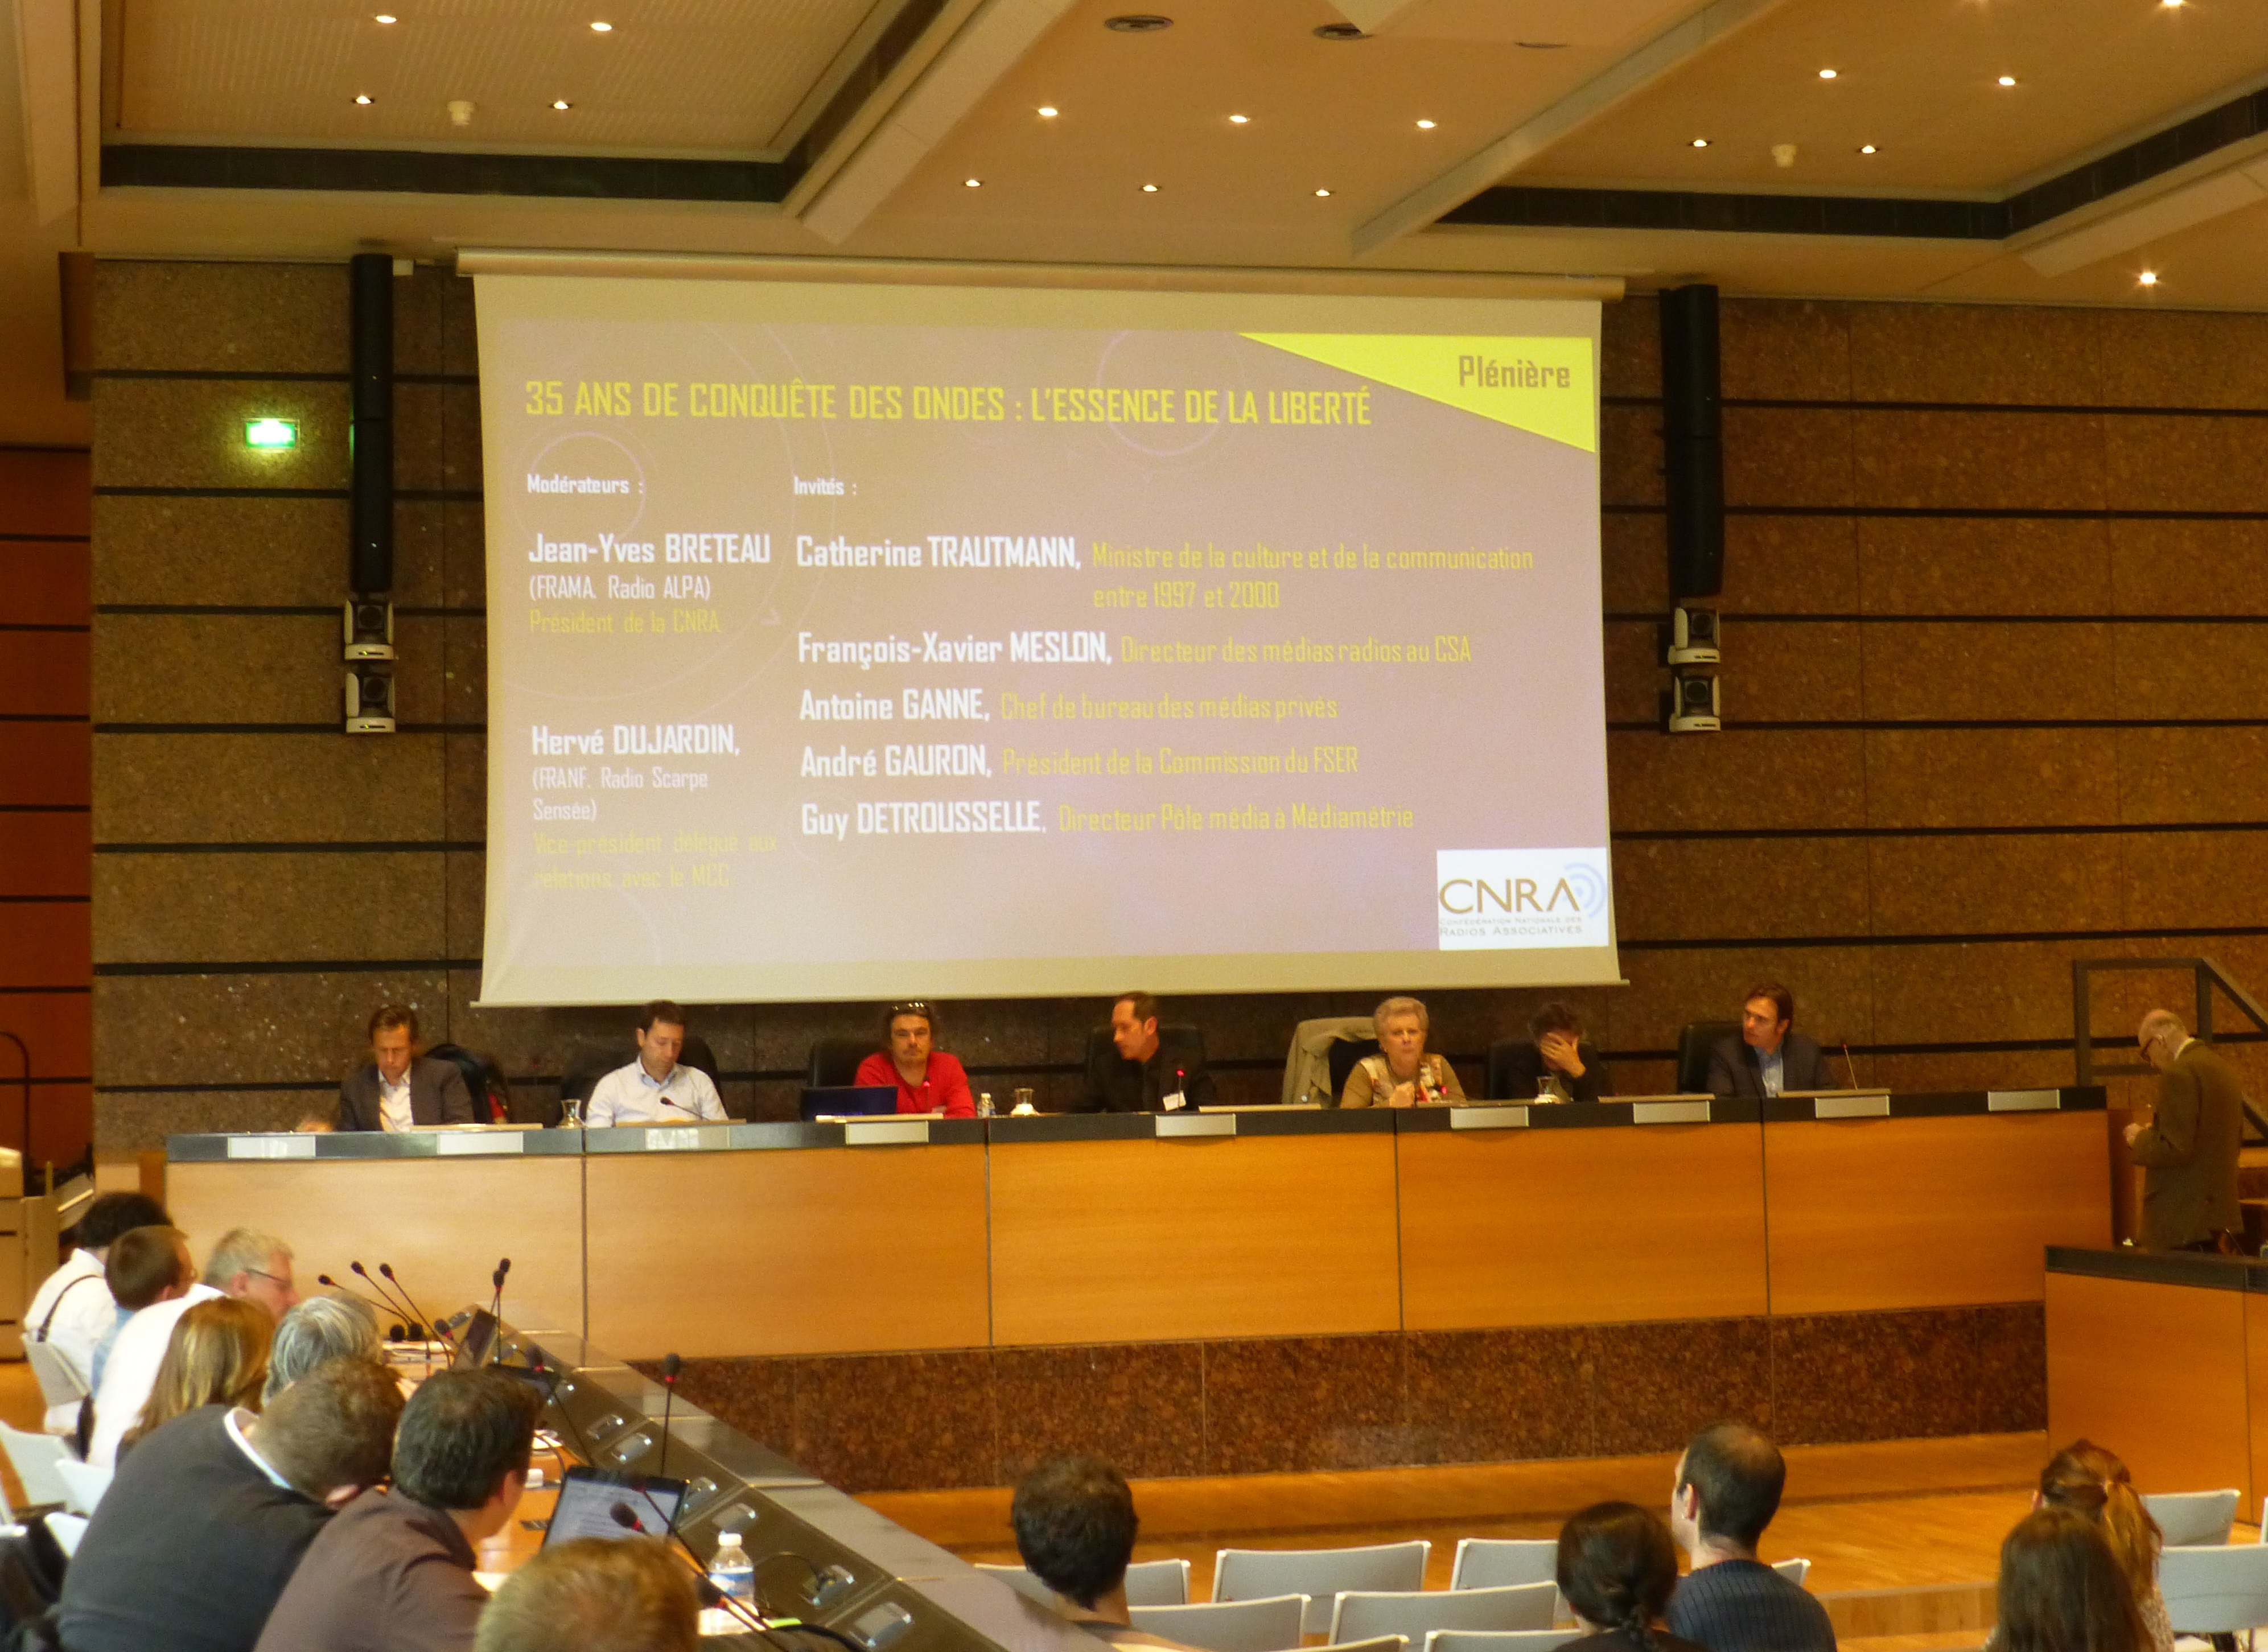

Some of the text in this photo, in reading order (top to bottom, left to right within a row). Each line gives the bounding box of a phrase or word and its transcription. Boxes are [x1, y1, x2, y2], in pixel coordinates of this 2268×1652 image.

[1459, 355, 1570, 388] Plénière
[525, 381, 563, 415] 35
[574, 381, 631, 416] ANS
[643, 382, 679, 417] DE
[690, 378, 837, 418] CONQUÊTE
[849, 385, 903, 419] DES
[913, 386, 1005, 420] ONDES
[1031, 388, 1175, 423] L'ESSENCE
[1185, 389, 1219, 423] DE
[1227, 390, 1258, 423] LA
[1269, 385, 1371, 425] LIBERTÉ
[527, 474, 629, 494] Modérateurs
[794, 476, 845, 495] Invités
[529, 533, 771, 563] Jean-Yves BRETEAU
[797, 535, 1534, 569] Catherine TRAUTMANN, Ministre de la culture et de la communication
[608, 575, 655, 599] Radio
[663, 575, 711, 601] ALPA)
[1094, 580, 1280, 608] entre 1997 et 2000
[529, 609, 721, 634] Président de la CNRA
[798, 632, 1472, 669] François-Xavier MESLON, Directeur des médias radios au CSA
[800, 689, 1339, 723] Antoine GANNE, Chef de bureau des médias privés
[532, 724, 741, 756] Hervé DUJARDIN,
[800, 745, 1359, 778] André GAURON, Président de la Commission du FSER
[601, 767, 644, 789] Radio
[652, 767, 709, 792] Scarpe
[532, 798, 598, 822] Sensée)
[802, 803, 850, 841] Guy
[1059, 804, 1156, 832] Directeur
[1161, 803, 1203, 831] Pôle
[1209, 804, 1270, 830] média
[1291, 803, 1415, 830] Médiamétrie
[748, 839, 778, 852] aux
[534, 867, 612, 889] relations
[621, 871, 661, 888] avec
[670, 863, 685, 886] le
[1439, 877, 1580, 914] CNRA
